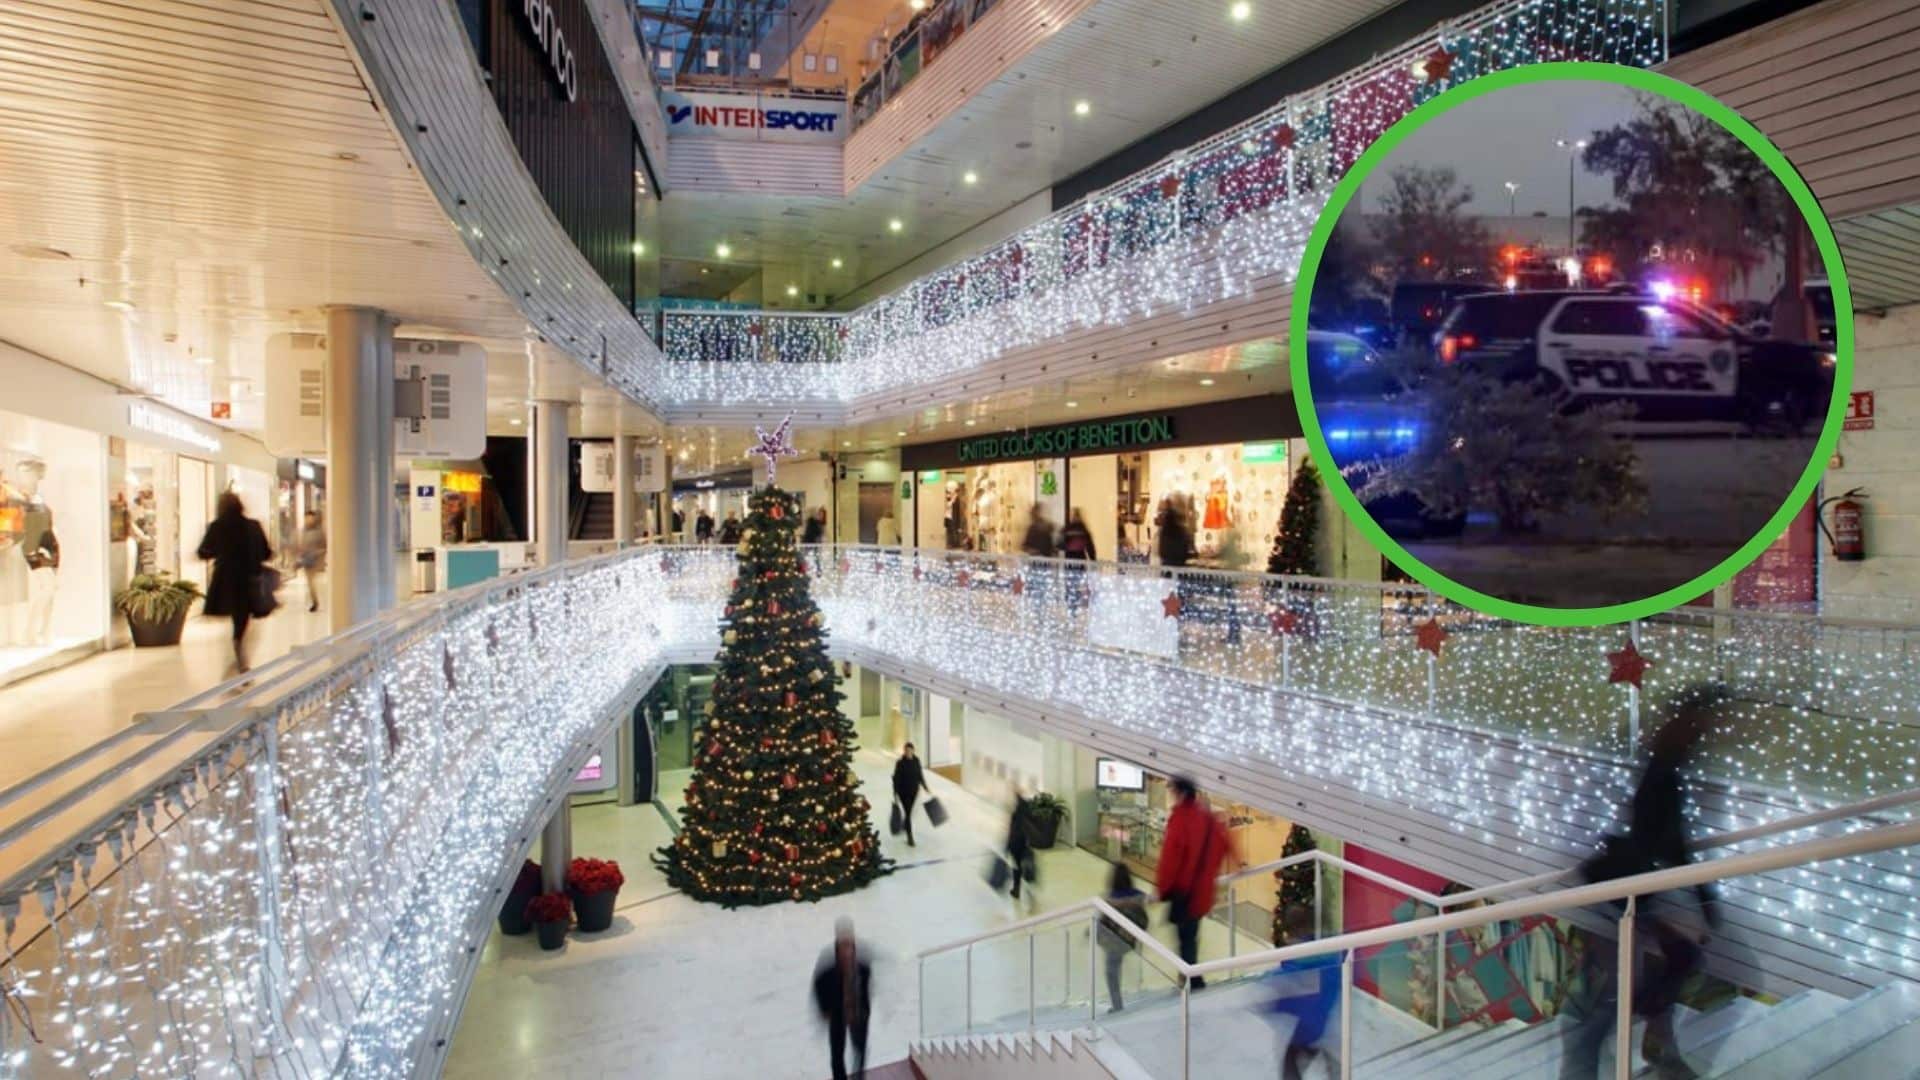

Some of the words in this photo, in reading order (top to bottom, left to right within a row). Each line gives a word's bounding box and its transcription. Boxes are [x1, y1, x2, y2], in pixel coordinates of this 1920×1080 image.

[524, 0, 577, 103] anco
[694, 105, 837, 132] INTERSPORT
[1566, 359, 1715, 390] POLICE
[959, 439, 998, 460] UNITED
[1002, 433, 1052, 456] COLORS
[1056, 430, 1075, 450] OF
